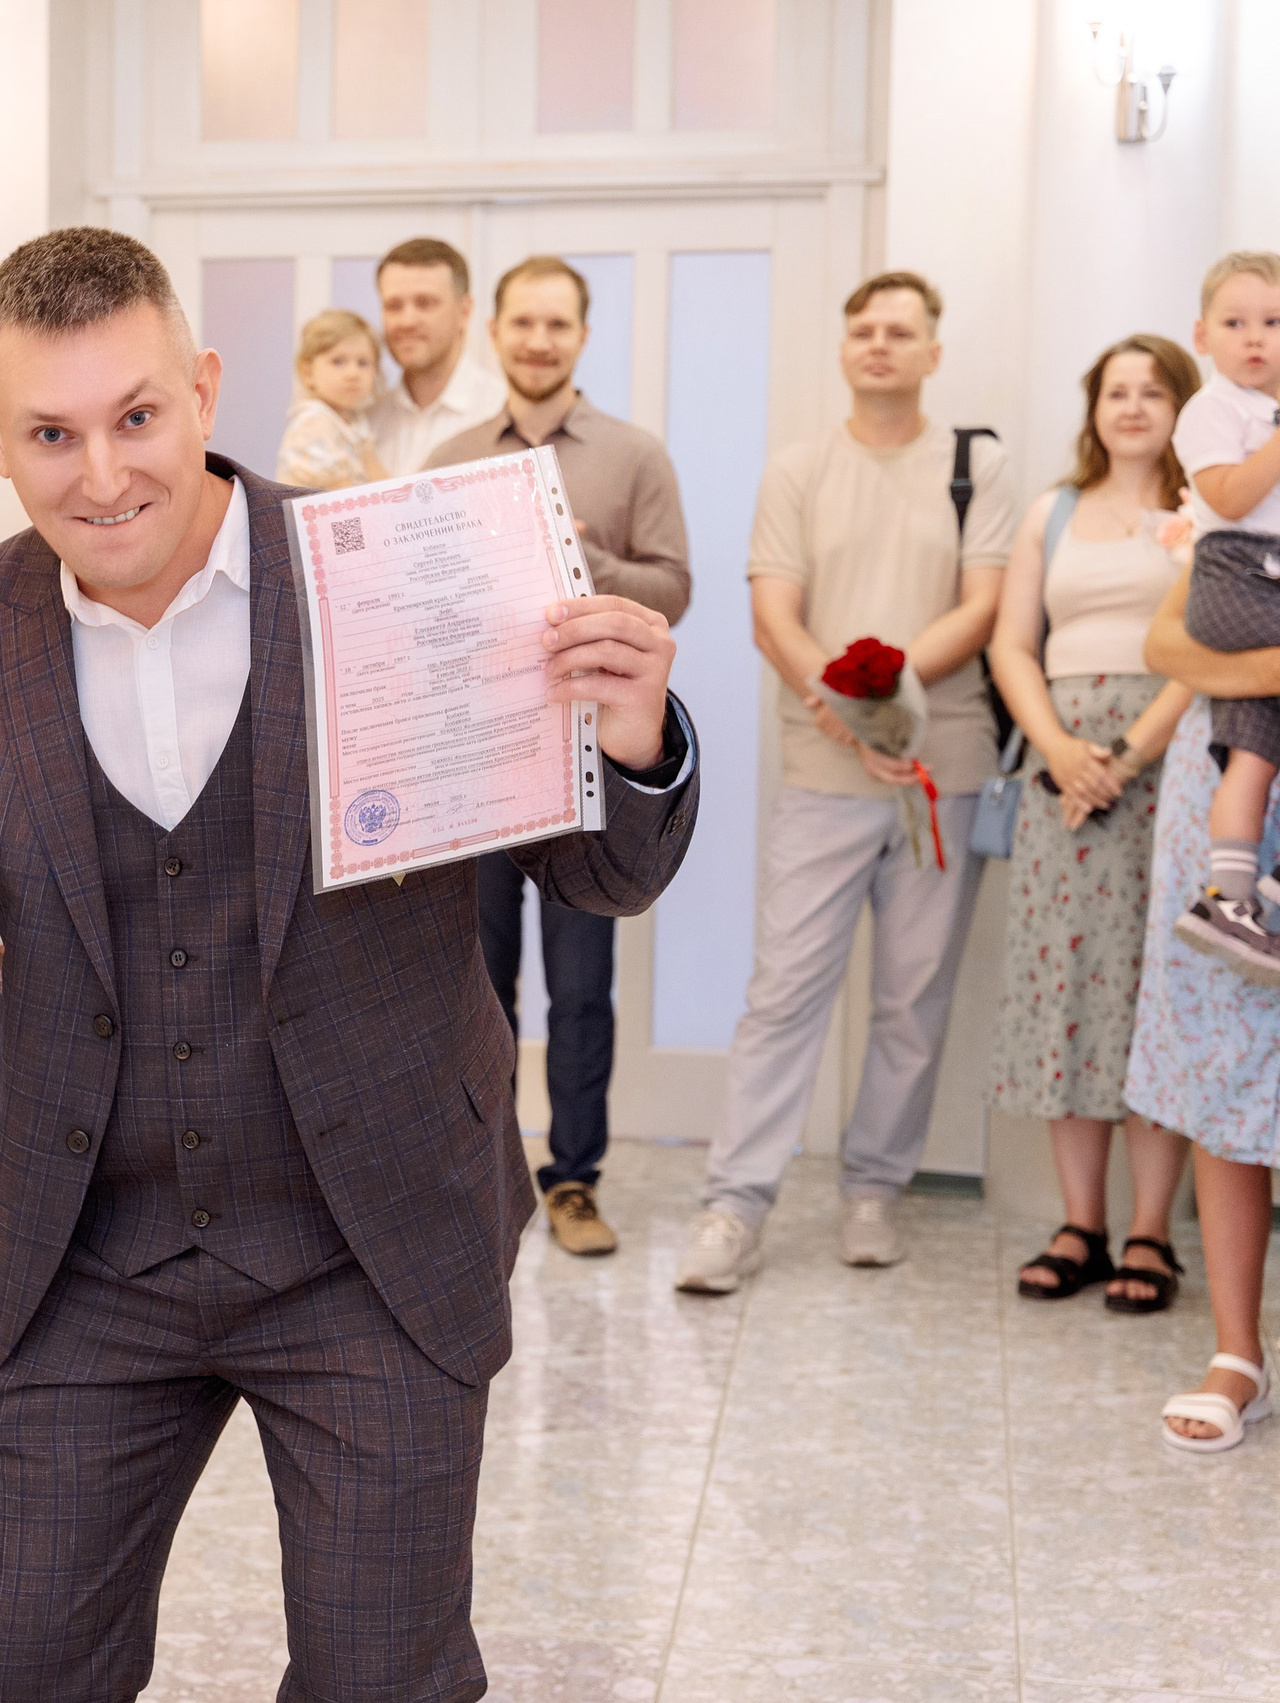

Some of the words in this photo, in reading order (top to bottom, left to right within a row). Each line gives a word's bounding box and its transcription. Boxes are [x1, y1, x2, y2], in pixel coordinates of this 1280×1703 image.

[395, 509, 466, 533] СВИДЕТЕЛЬСТВО
[383, 538, 390, 547] О
[393, 524, 454, 545] ЗАКЛЮЧЕНИИ
[455, 518, 482, 531] БРАКА
[413, 558, 433, 569] Сергей
[434, 552, 461, 564] Юрьевич
[409, 570, 440, 582] Российская
[441, 564, 469, 576] Федерация
[356, 596, 380, 607] февраля
[467, 573, 488, 583] русский
[365, 601, 390, 611] рождения)
[393, 598, 433, 612] Красноярский
[434, 594, 448, 603] край,
[440, 598, 465, 608] рождения)
[414, 622, 445, 634] Елизавета
[446, 614, 479, 628] Андреевна
[417, 634, 448, 647] Российская
[449, 628, 479, 640] Федерация
[362, 660, 385, 670] октября
[476, 637, 497, 647] русская
[439, 654, 470, 667] Красноярск
[462, 674, 480, 683] месяца
[339, 687, 372, 699] заключили
[373, 684, 386, 692] брак
[340, 705, 372, 717] составлена
[373, 701, 391, 710] запись
[412, 689, 446, 701] заключении
[447, 685, 463, 694] брака
[341, 727, 358, 735] После
[359, 719, 393, 732] заключения
[394, 715, 410, 724] брака
[412, 709, 443, 721] присвоены
[341, 735, 357, 743] мужу
[342, 748, 358, 756] Место
[359, 738, 401, 753] государственной
[463, 714, 503, 729] Железногорский
[343, 777, 358, 785] Место
[360, 773, 379, 781] выдачи
[380, 764, 416, 777] свидетельства
